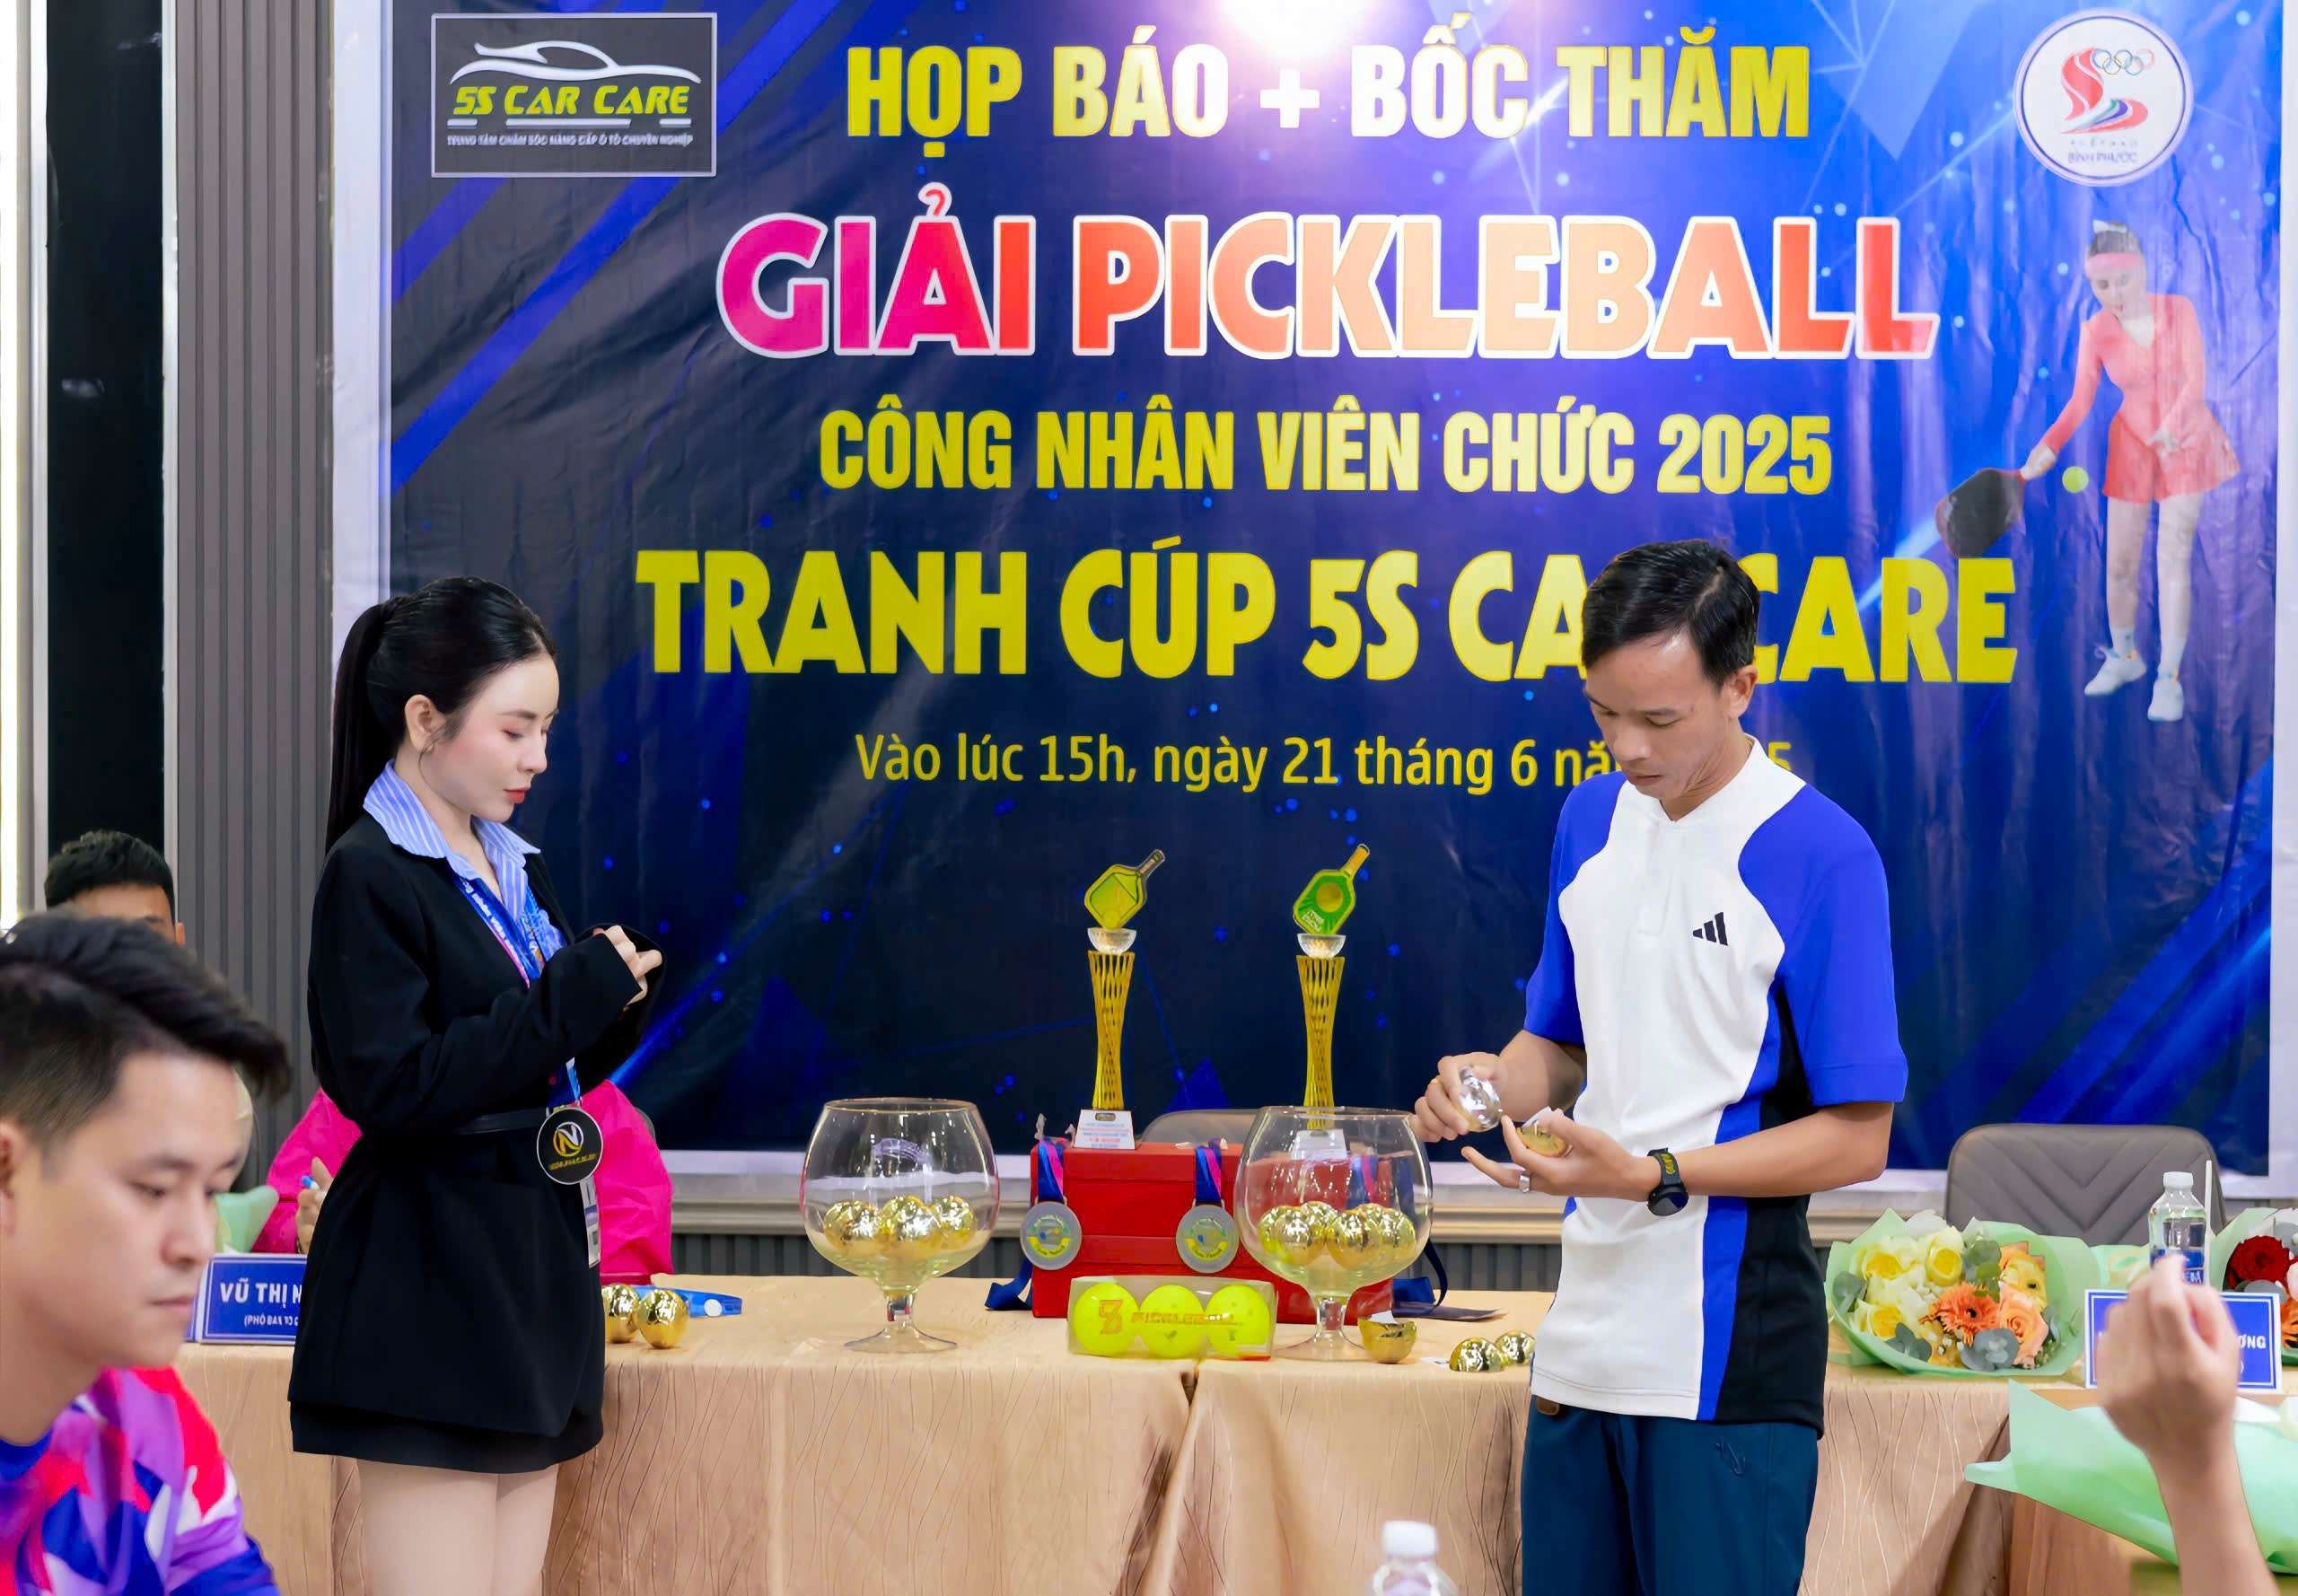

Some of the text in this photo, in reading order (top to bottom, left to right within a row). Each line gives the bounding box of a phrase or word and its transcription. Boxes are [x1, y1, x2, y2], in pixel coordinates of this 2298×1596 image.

[452, 85, 690, 116] 5S CAR CARE
[847, 13, 1810, 157] HỌP BÁO + BỐC THĂM
[717, 182, 1941, 360] GIẢI PICKLEBALL
[820, 393, 1831, 495] CÔNG NHÂN VIÊN CHỨC 2025
[636, 549, 1027, 675] TRANH
[1059, 535, 1276, 680] CÚP
[1302, 549, 1419, 682] 5S
[1447, 550, 1587, 682] CA
[855, 732, 1619, 795] Vào lúc 15h, ngày 21 tháng 6 nă
[219, 1276, 250, 1303] VŨ
[255, 1283, 288, 1309] THỊ
